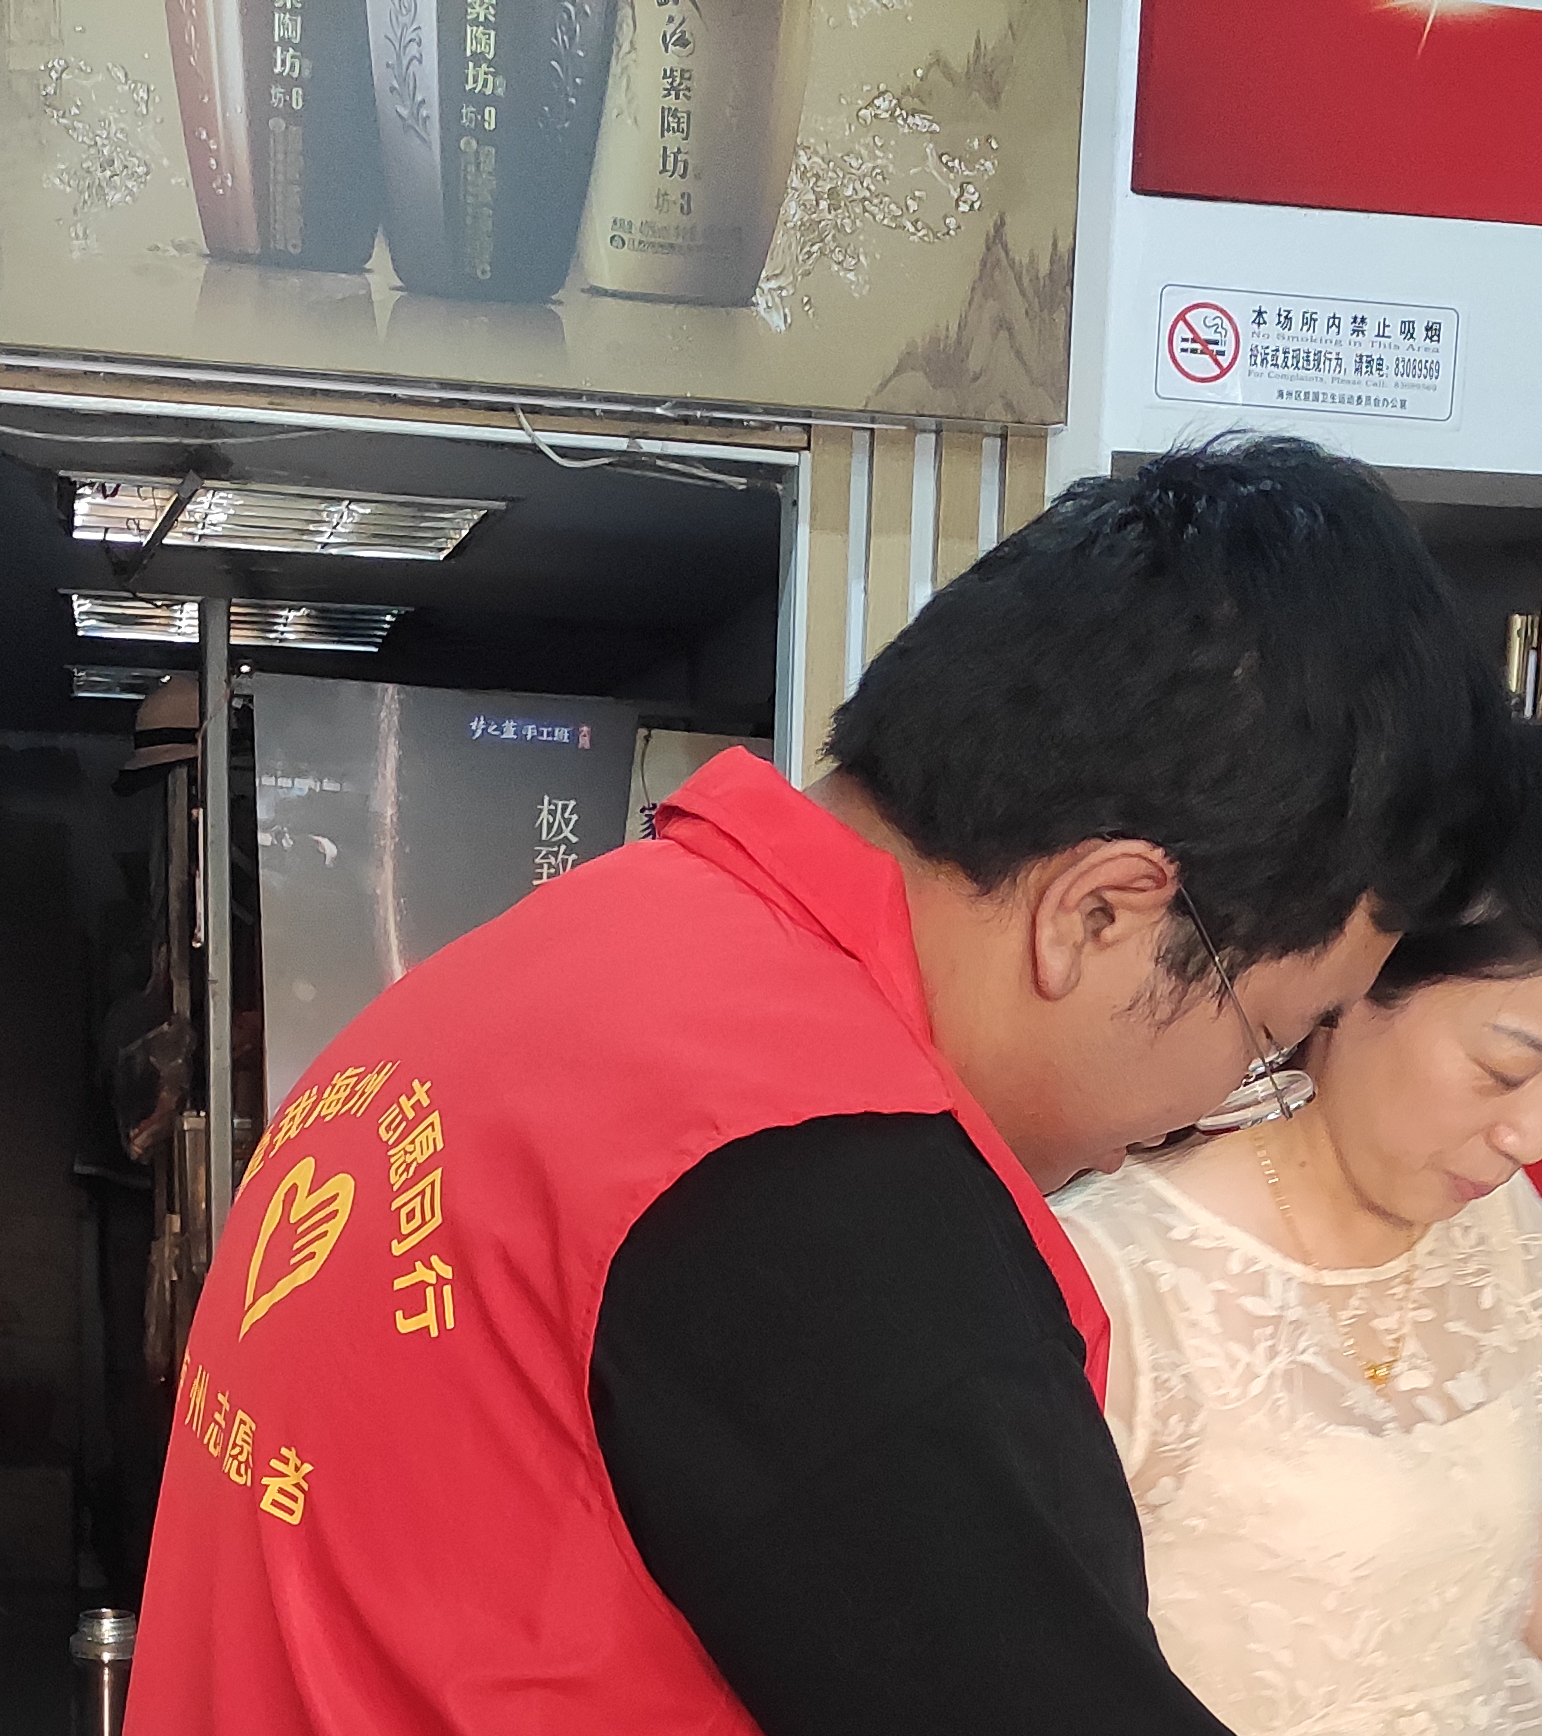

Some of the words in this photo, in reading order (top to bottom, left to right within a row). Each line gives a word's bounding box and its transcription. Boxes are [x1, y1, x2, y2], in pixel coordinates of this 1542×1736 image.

[659, 66, 696, 180] 紫陶坊
[1251, 305, 1442, 345] 本场所内禁止吸烟
[1251, 331, 1270, 340] No
[1276, 332, 1344, 348] Smoking
[1370, 340, 1403, 351] This
[1406, 344, 1440, 354] Area
[378, 1078, 456, 1339] 志愿同行
[178, 1348, 315, 1526] 州志愿者
